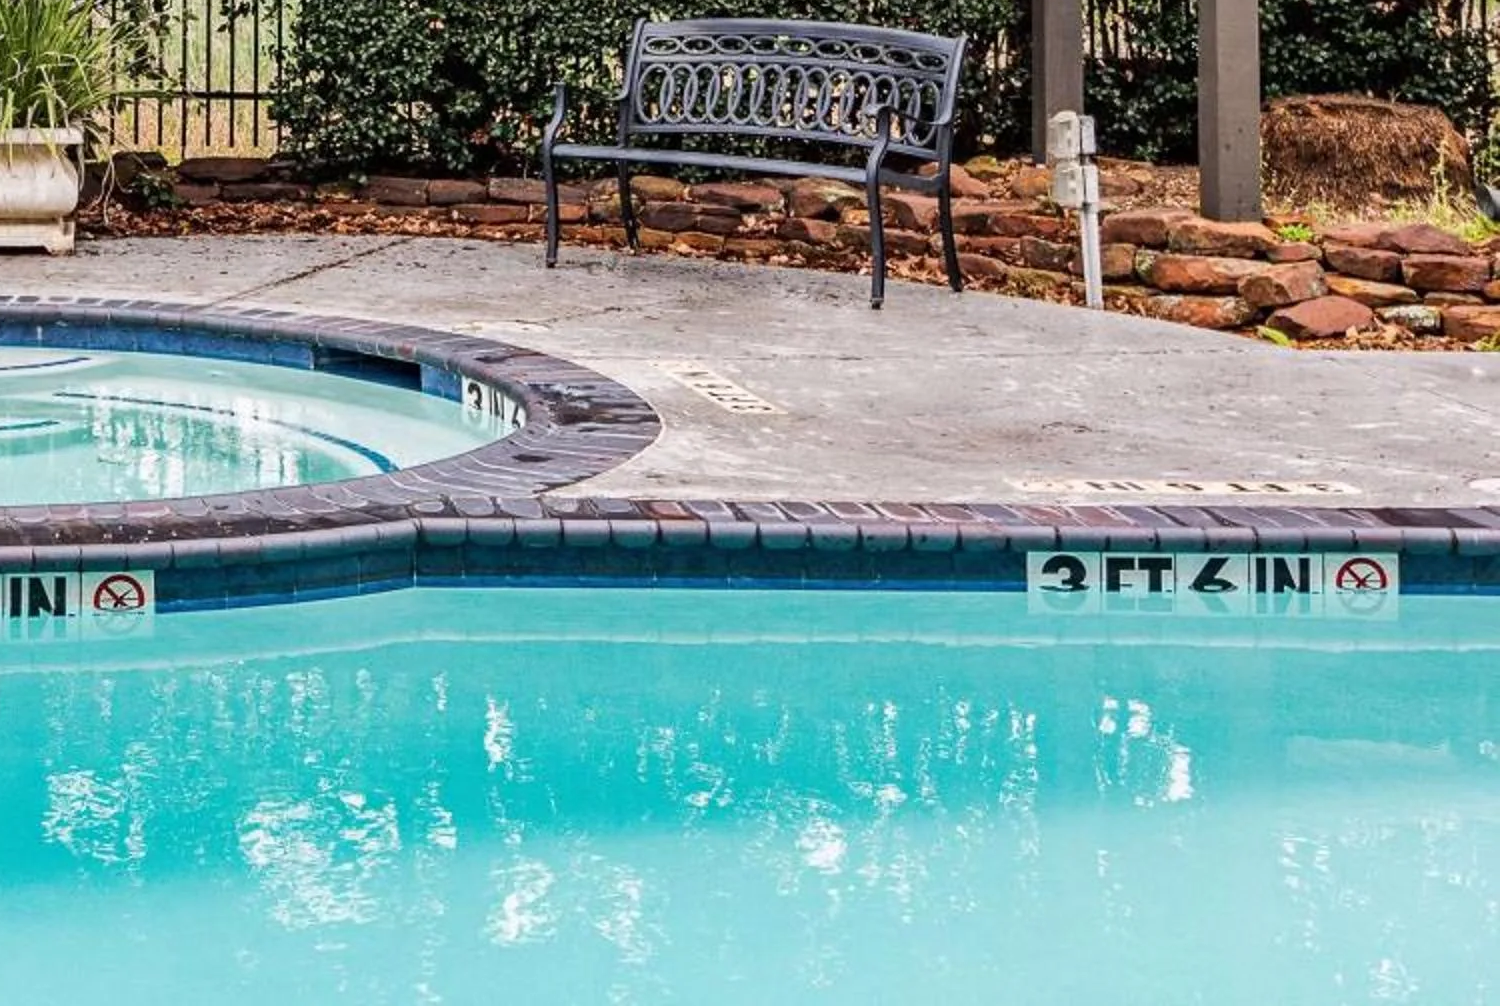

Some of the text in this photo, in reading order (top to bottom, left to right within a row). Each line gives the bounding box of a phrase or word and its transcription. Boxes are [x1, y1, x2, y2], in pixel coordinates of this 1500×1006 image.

[467, 382, 483, 411] 3
[1039, 555, 1090, 592] 3
[1188, 557, 1239, 592] 6
